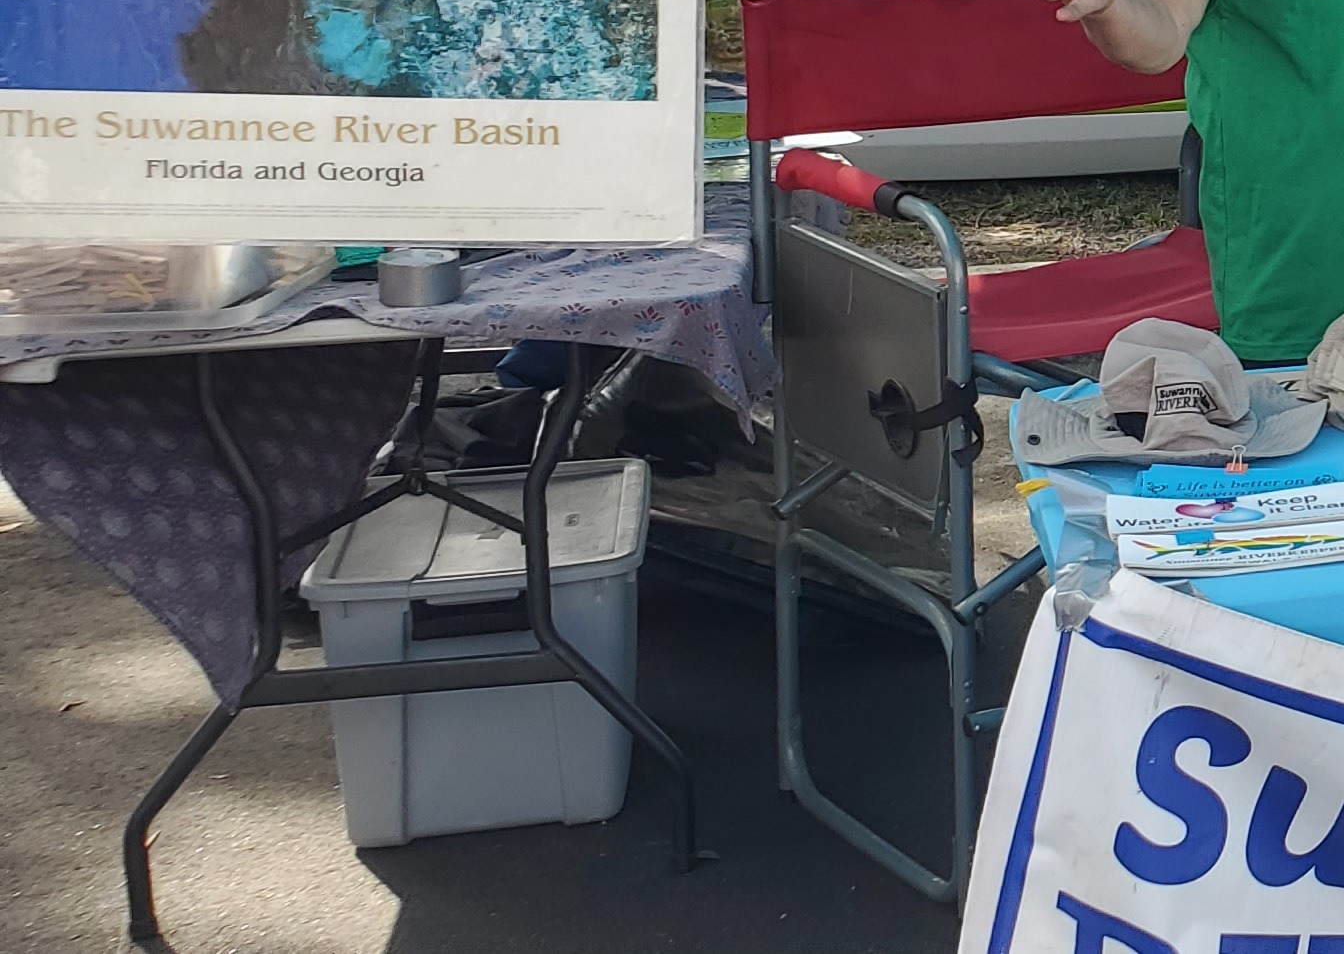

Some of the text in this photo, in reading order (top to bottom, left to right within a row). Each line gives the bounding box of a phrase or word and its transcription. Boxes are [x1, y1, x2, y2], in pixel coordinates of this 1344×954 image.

[0, 108, 561, 147] The Suwannee River Basin
[145, 158, 425, 188] Florida and Georgia
[1160, 387, 1202, 399] Suwann
[1157, 396, 1203, 412] RIVERK
[1176, 477, 1305, 492] Life is better on
[1257, 493, 1319, 508] Keep
[1269, 506, 1283, 515] it
[1115, 515, 1185, 528] Water
